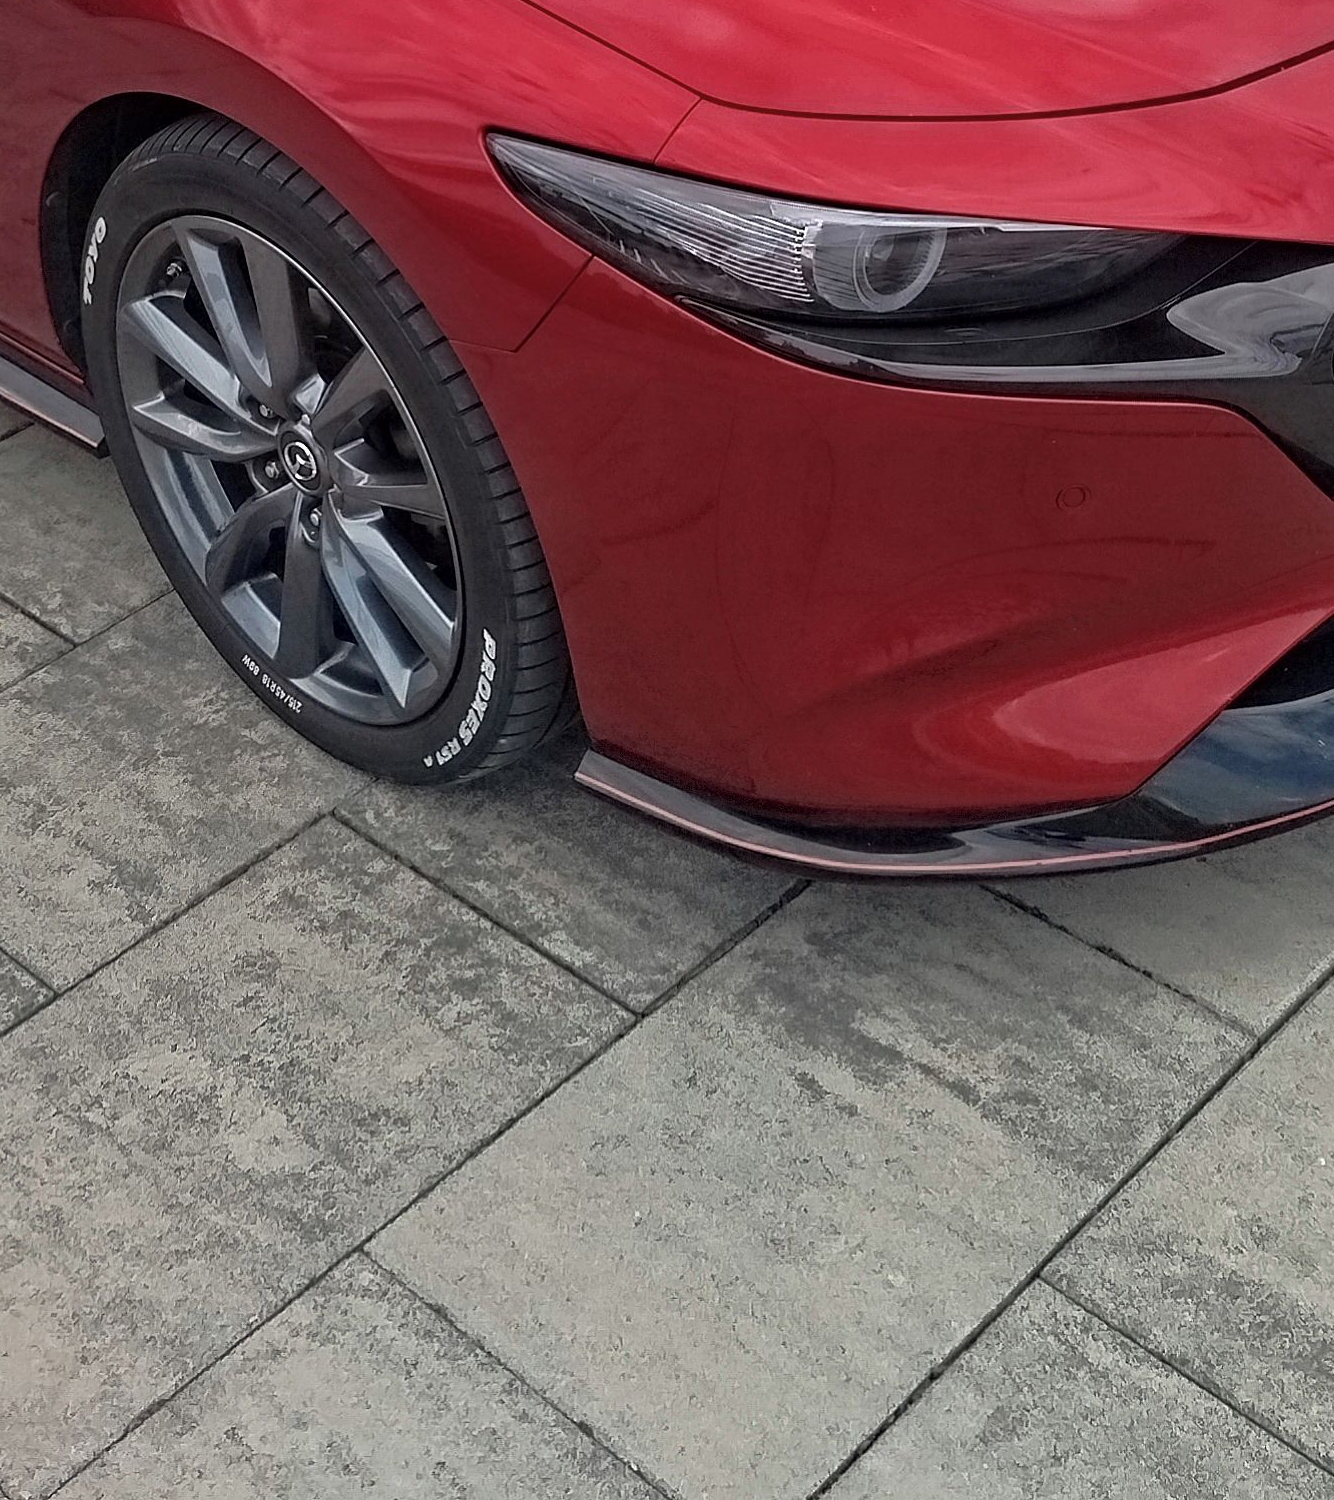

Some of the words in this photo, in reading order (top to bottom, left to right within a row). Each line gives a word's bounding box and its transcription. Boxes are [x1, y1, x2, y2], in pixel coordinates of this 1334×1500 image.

[82, 216, 107, 305] TOYO
[262, 673, 303, 714] 215/45R18
[458, 627, 497, 747] PROXES
